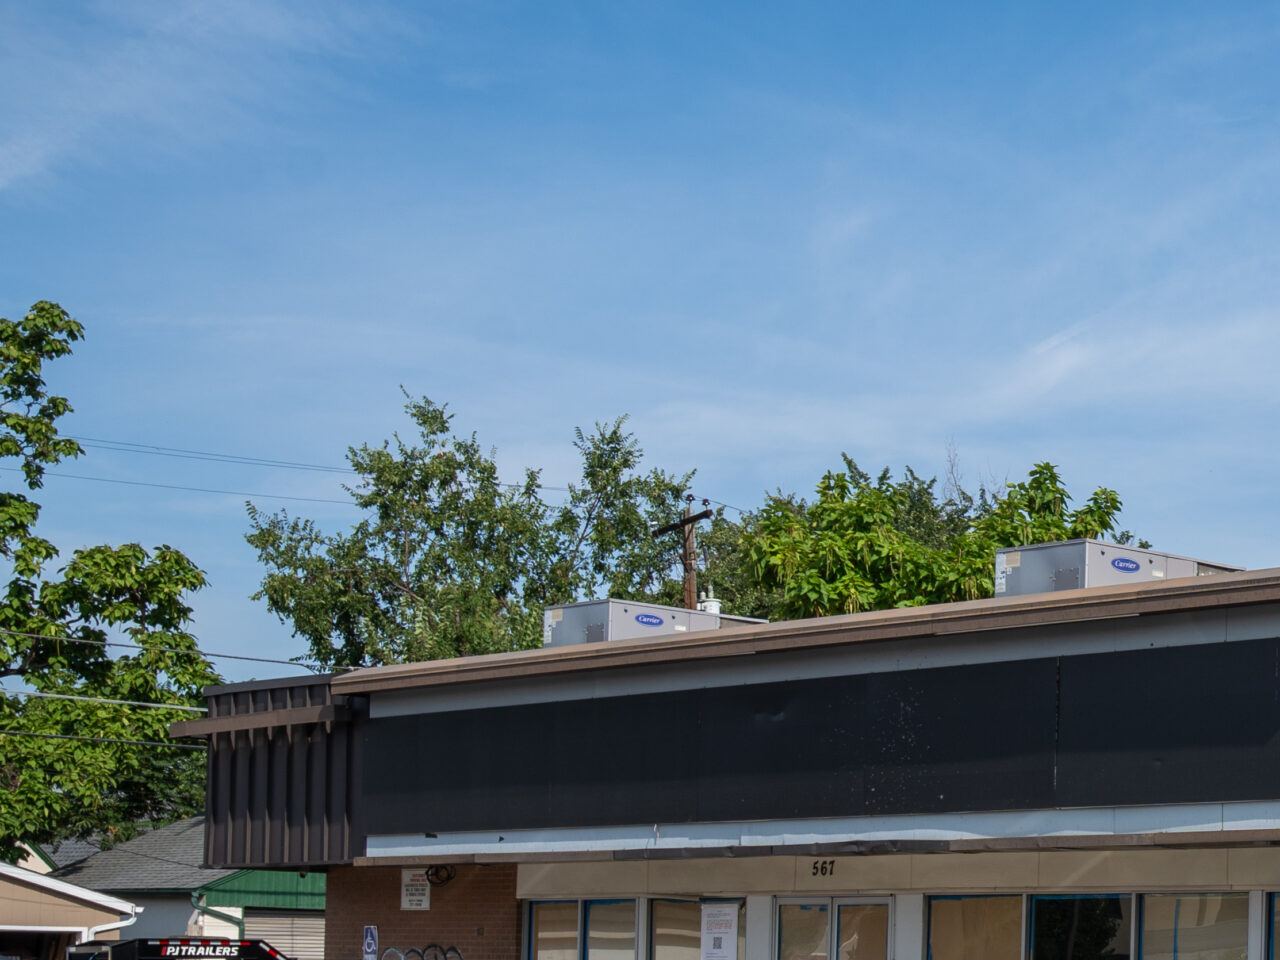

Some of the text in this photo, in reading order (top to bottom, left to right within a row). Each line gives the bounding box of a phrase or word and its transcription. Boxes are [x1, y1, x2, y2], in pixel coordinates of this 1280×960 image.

[1114, 559, 1137, 570] Carrier
[638, 615, 661, 625] Carrier
[812, 860, 835, 876] 567
[166, 946, 239, 957] PJ TRAILERS
